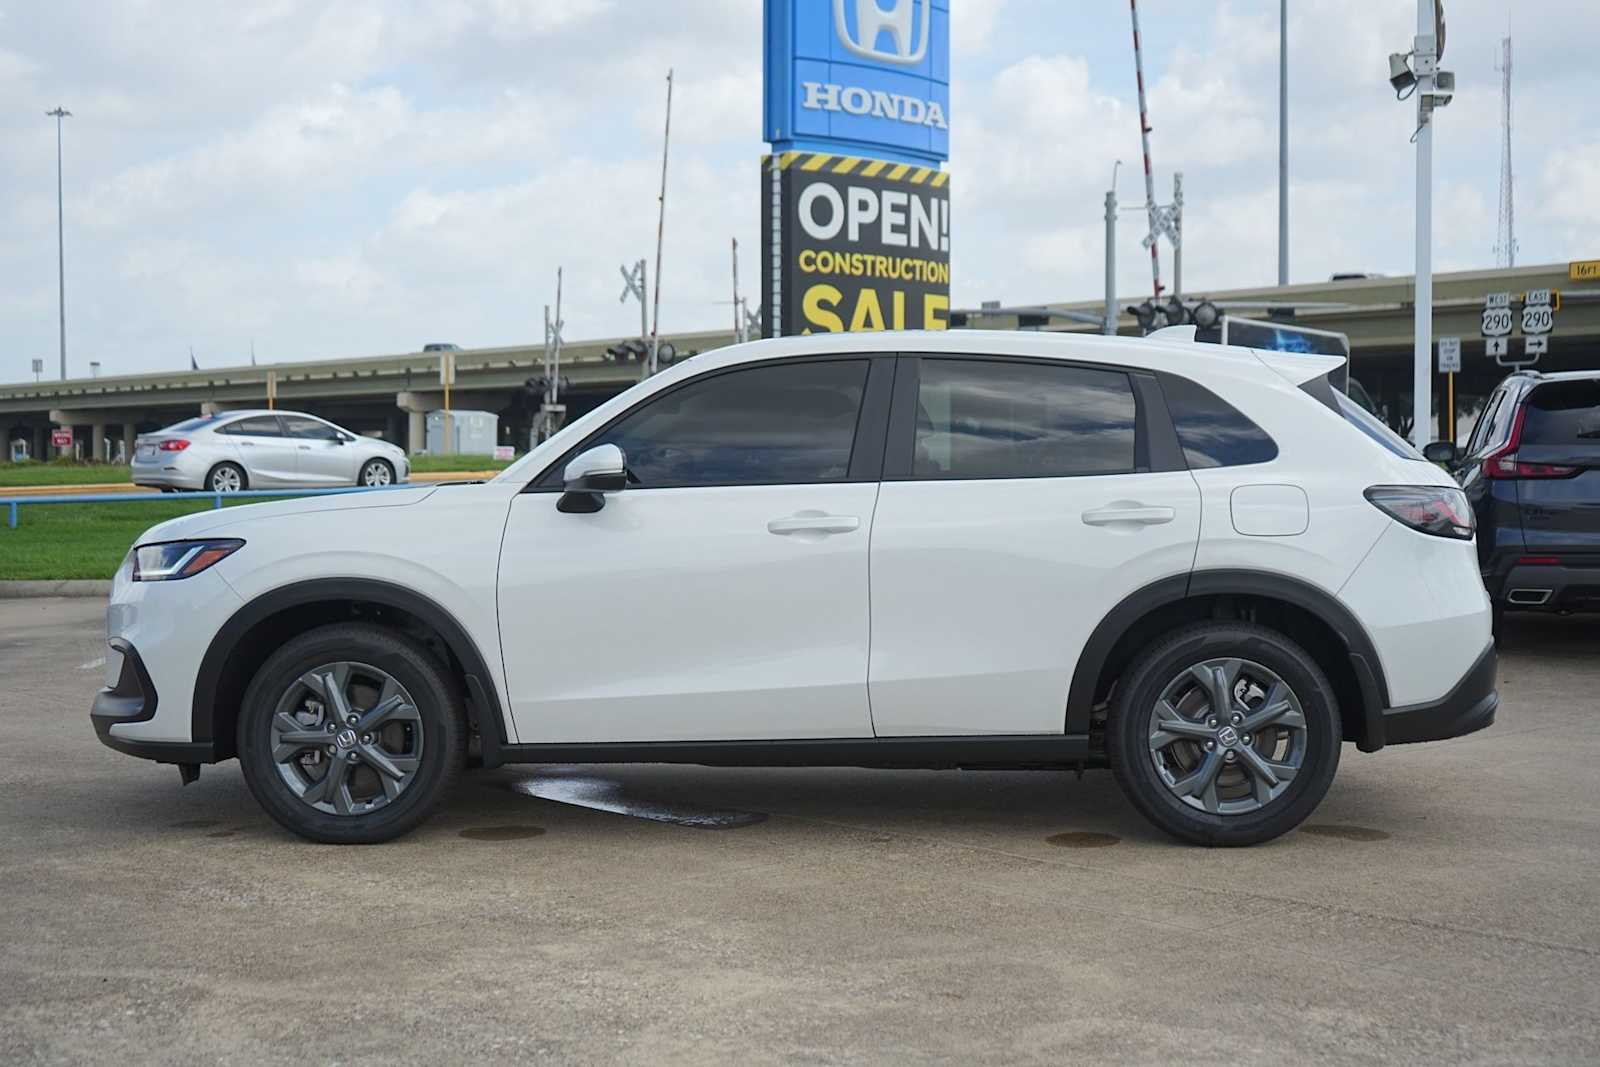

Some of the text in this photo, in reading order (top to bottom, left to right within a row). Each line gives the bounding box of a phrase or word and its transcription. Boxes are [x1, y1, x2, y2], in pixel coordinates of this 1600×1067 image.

[802, 81, 948, 129] HONDA
[798, 182, 949, 251] OPEN!
[799, 249, 949, 283] CONSTRUCTION
[1488, 295, 1507, 305] WEST
[1528, 290, 1547, 301] EAST
[1485, 313, 1509, 330] 290
[1525, 311, 1549, 328] 290
